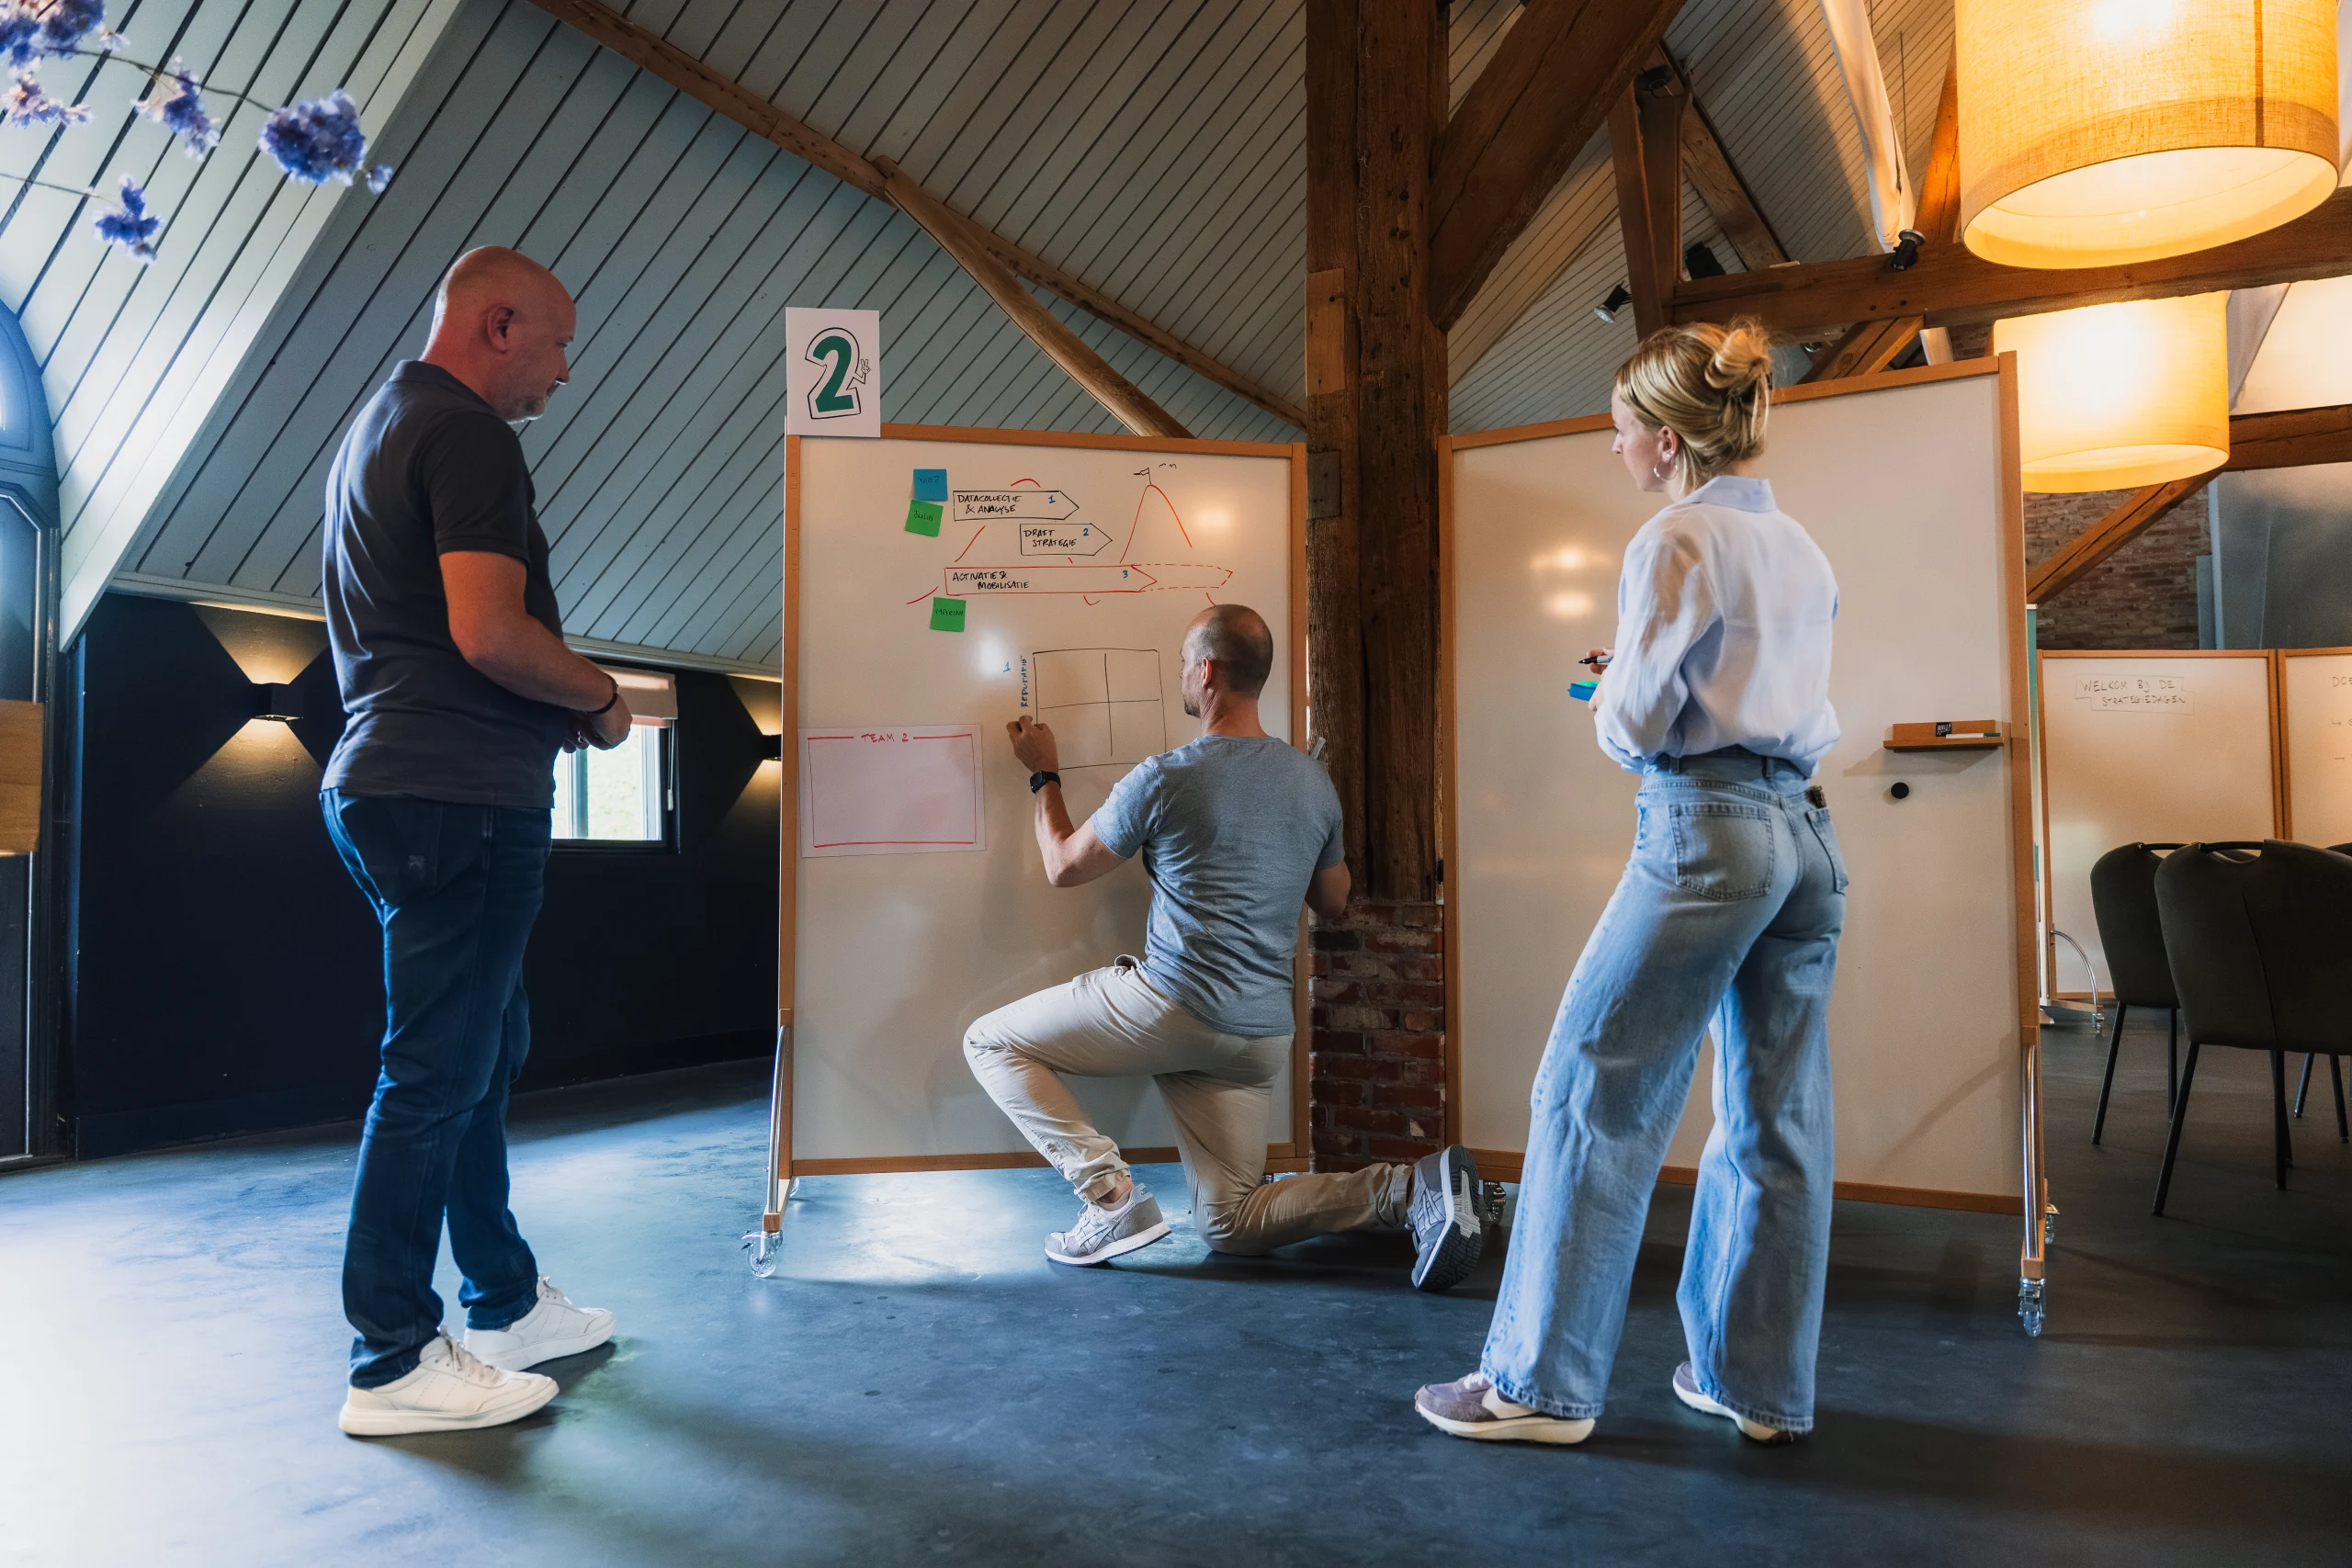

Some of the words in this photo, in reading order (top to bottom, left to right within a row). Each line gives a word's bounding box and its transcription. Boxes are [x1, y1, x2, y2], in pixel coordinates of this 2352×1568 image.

[805, 327, 862, 420] 2
[956, 494, 1023, 503] DATACOLLECTIE
[1047, 494, 1056, 504] 1
[965, 503, 975, 514] &
[977, 504, 1016, 515] ANALYSE
[1023, 528, 1056, 537] DRAFT
[1082, 527, 1090, 536] 2
[1032, 538, 1078, 548] STRATEGIE
[952, 570, 999, 582] ACTIVATIE
[1122, 570, 1129, 579] 3
[977, 581, 1030, 590] MOBILISATIE
[1020, 655, 1029, 707] REPUTATIE
[2081, 680, 2127, 693] WELKOM
[2158, 680, 2176, 690] DE
[861, 733, 895, 743] TEAM
[901, 732, 909, 742] 2
